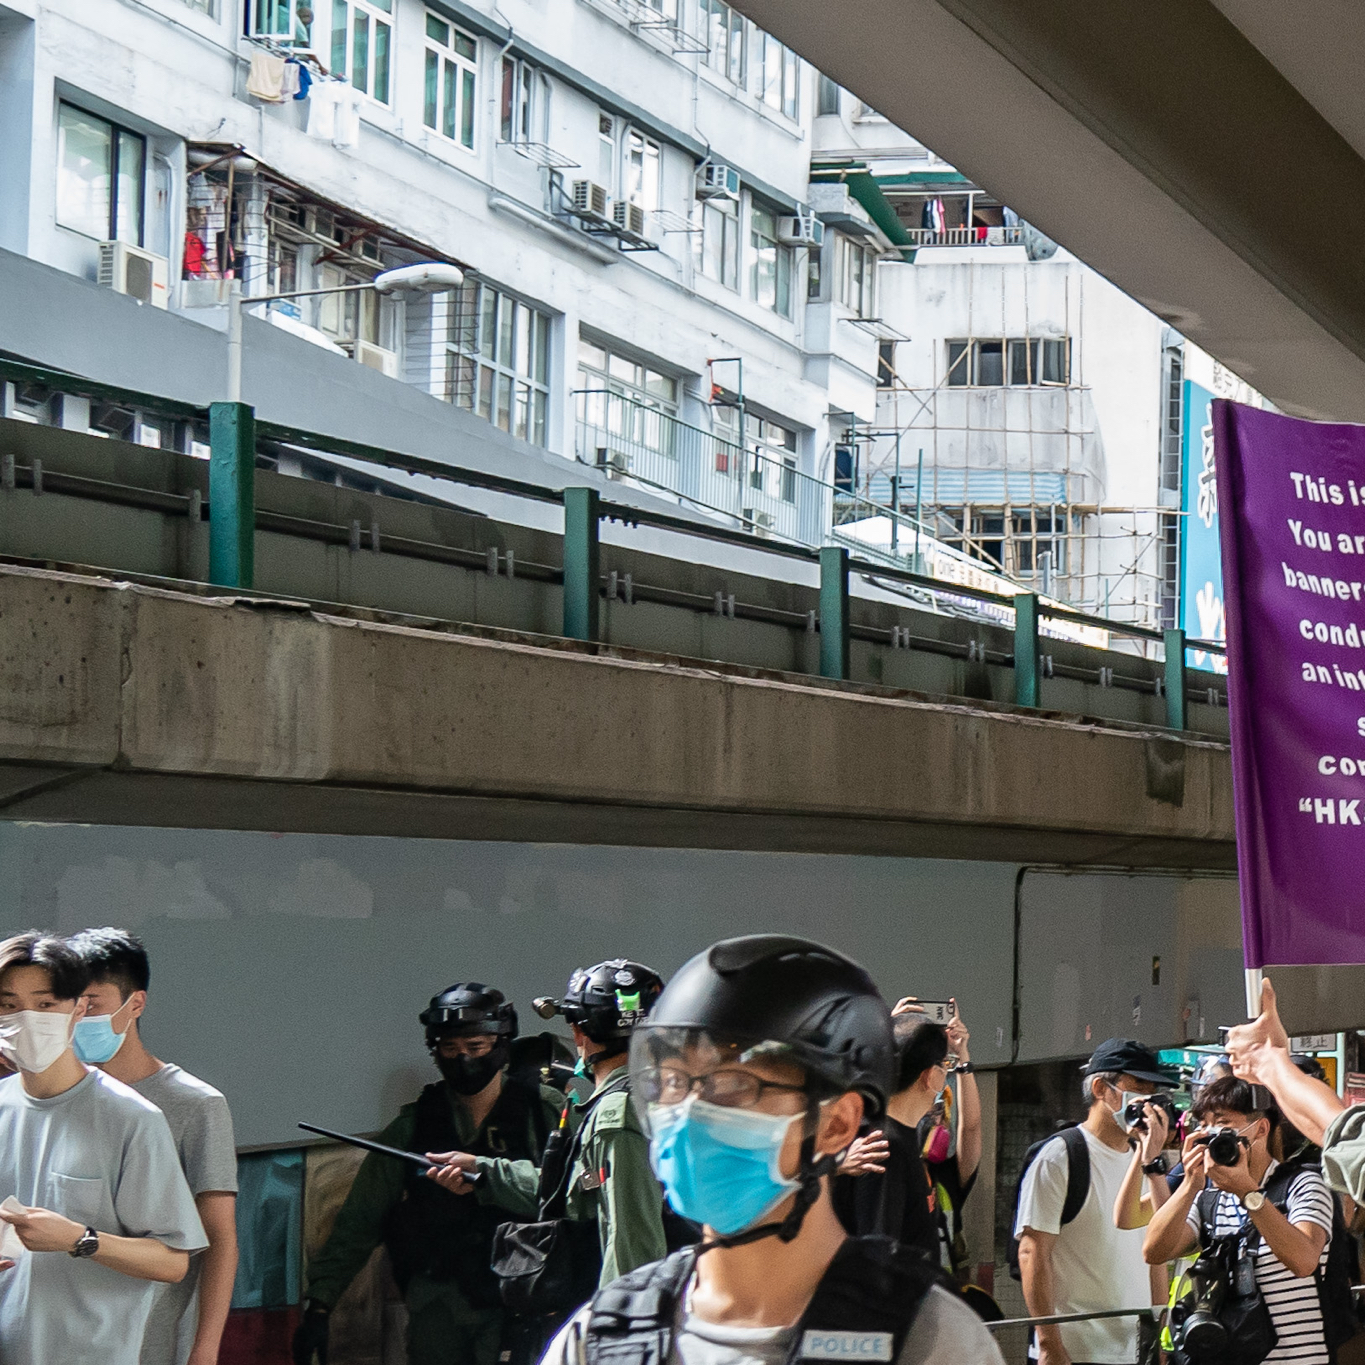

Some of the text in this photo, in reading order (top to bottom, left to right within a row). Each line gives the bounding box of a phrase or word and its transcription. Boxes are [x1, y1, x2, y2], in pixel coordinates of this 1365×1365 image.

[1289, 471, 1344, 505] This
[1287, 518, 1332, 552] You
[1301, 662, 1334, 685] an
[809, 1336, 886, 1355] POLICE
